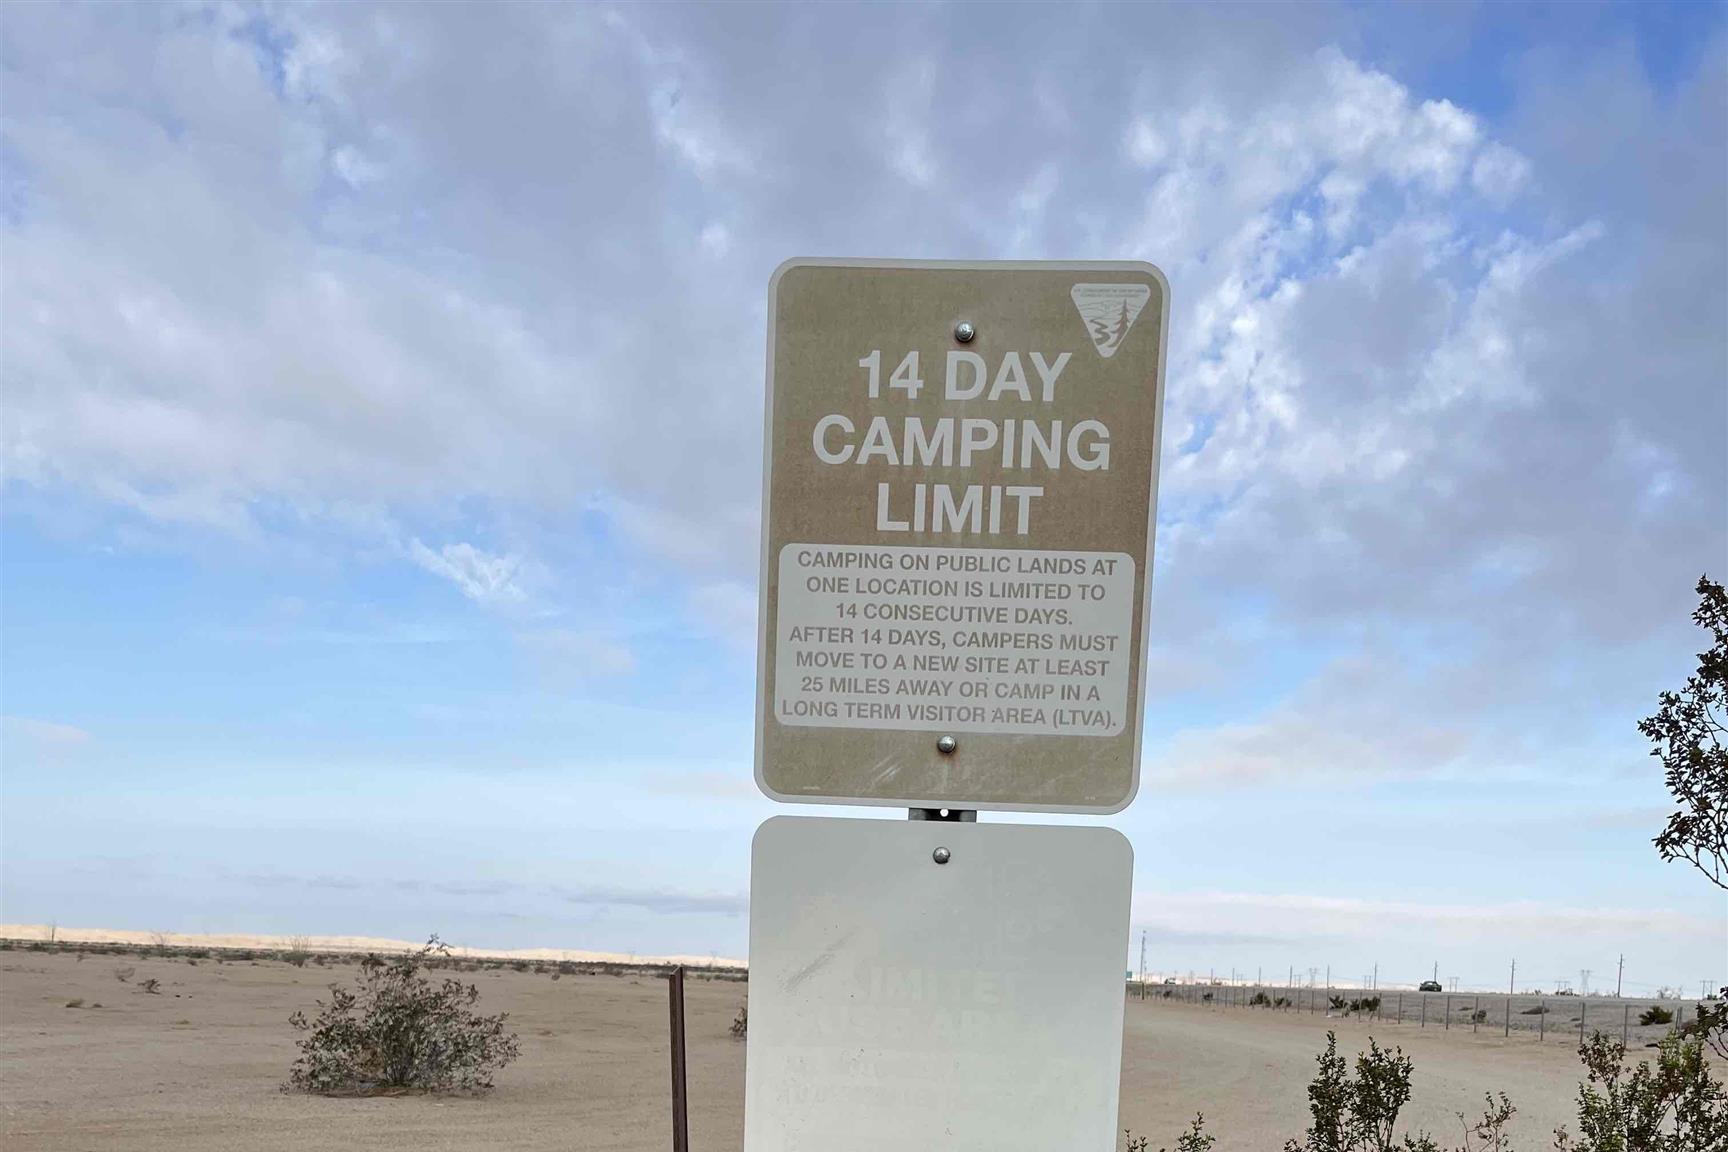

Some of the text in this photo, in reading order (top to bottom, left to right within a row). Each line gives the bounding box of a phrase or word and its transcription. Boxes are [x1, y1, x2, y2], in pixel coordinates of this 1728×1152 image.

[859, 350, 1072, 402] 14 DAY
[813, 414, 1110, 471] CAMPING
[877, 482, 1044, 535] LIMIT
[798, 551, 1117, 575] CAMPING ON PUBLIC LANDS AT
[806, 576, 1106, 600] ONE LOCATION IS LIMITED TO
[836, 603, 1072, 625] 14 CONSECUTIVE DAYS.
[789, 627, 1118, 652] AFTER 14 DAYS, CAMPERS MUST
[797, 651, 1110, 676] MOVE TO A NEW SITE AT LEAST
[802, 676, 1100, 701] 25 MILES AWAY OR CAMP IN A
[782, 700, 1116, 729] LONG TERM VISITOR AREA (LTVA).
